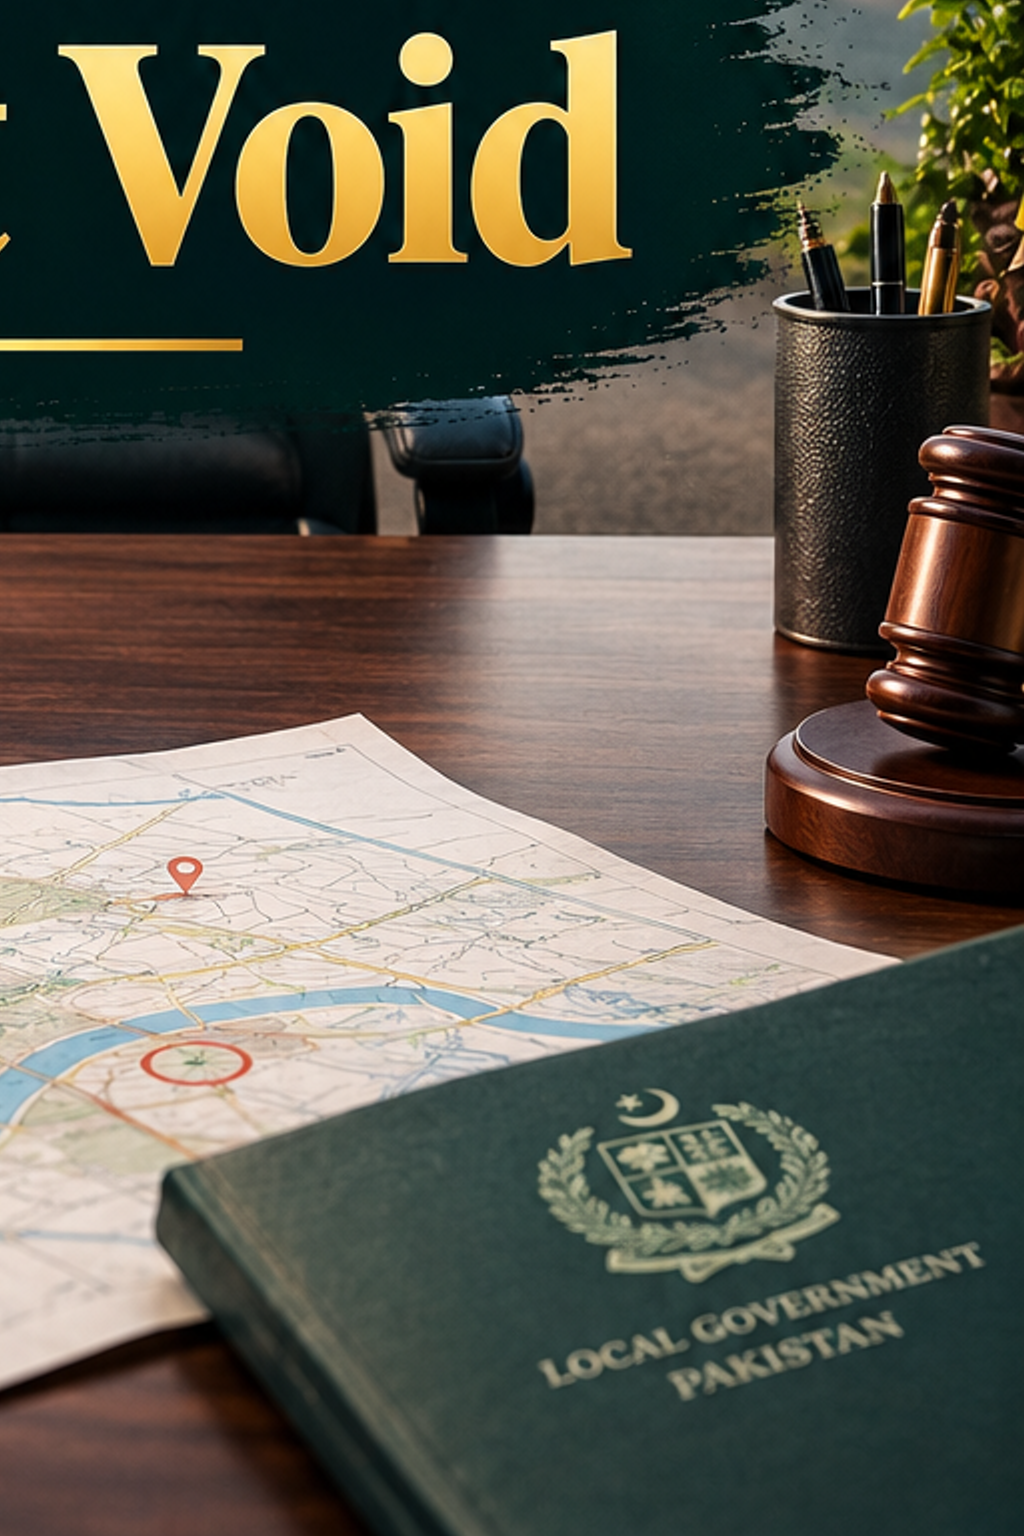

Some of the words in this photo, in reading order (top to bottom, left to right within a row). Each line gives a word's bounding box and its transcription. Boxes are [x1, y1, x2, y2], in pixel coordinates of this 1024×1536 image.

[538, 1327, 690, 1388] LOCAL
[690, 1241, 985, 1344] GOVERNMENT
[667, 1310, 904, 1401] PAKISTAN
